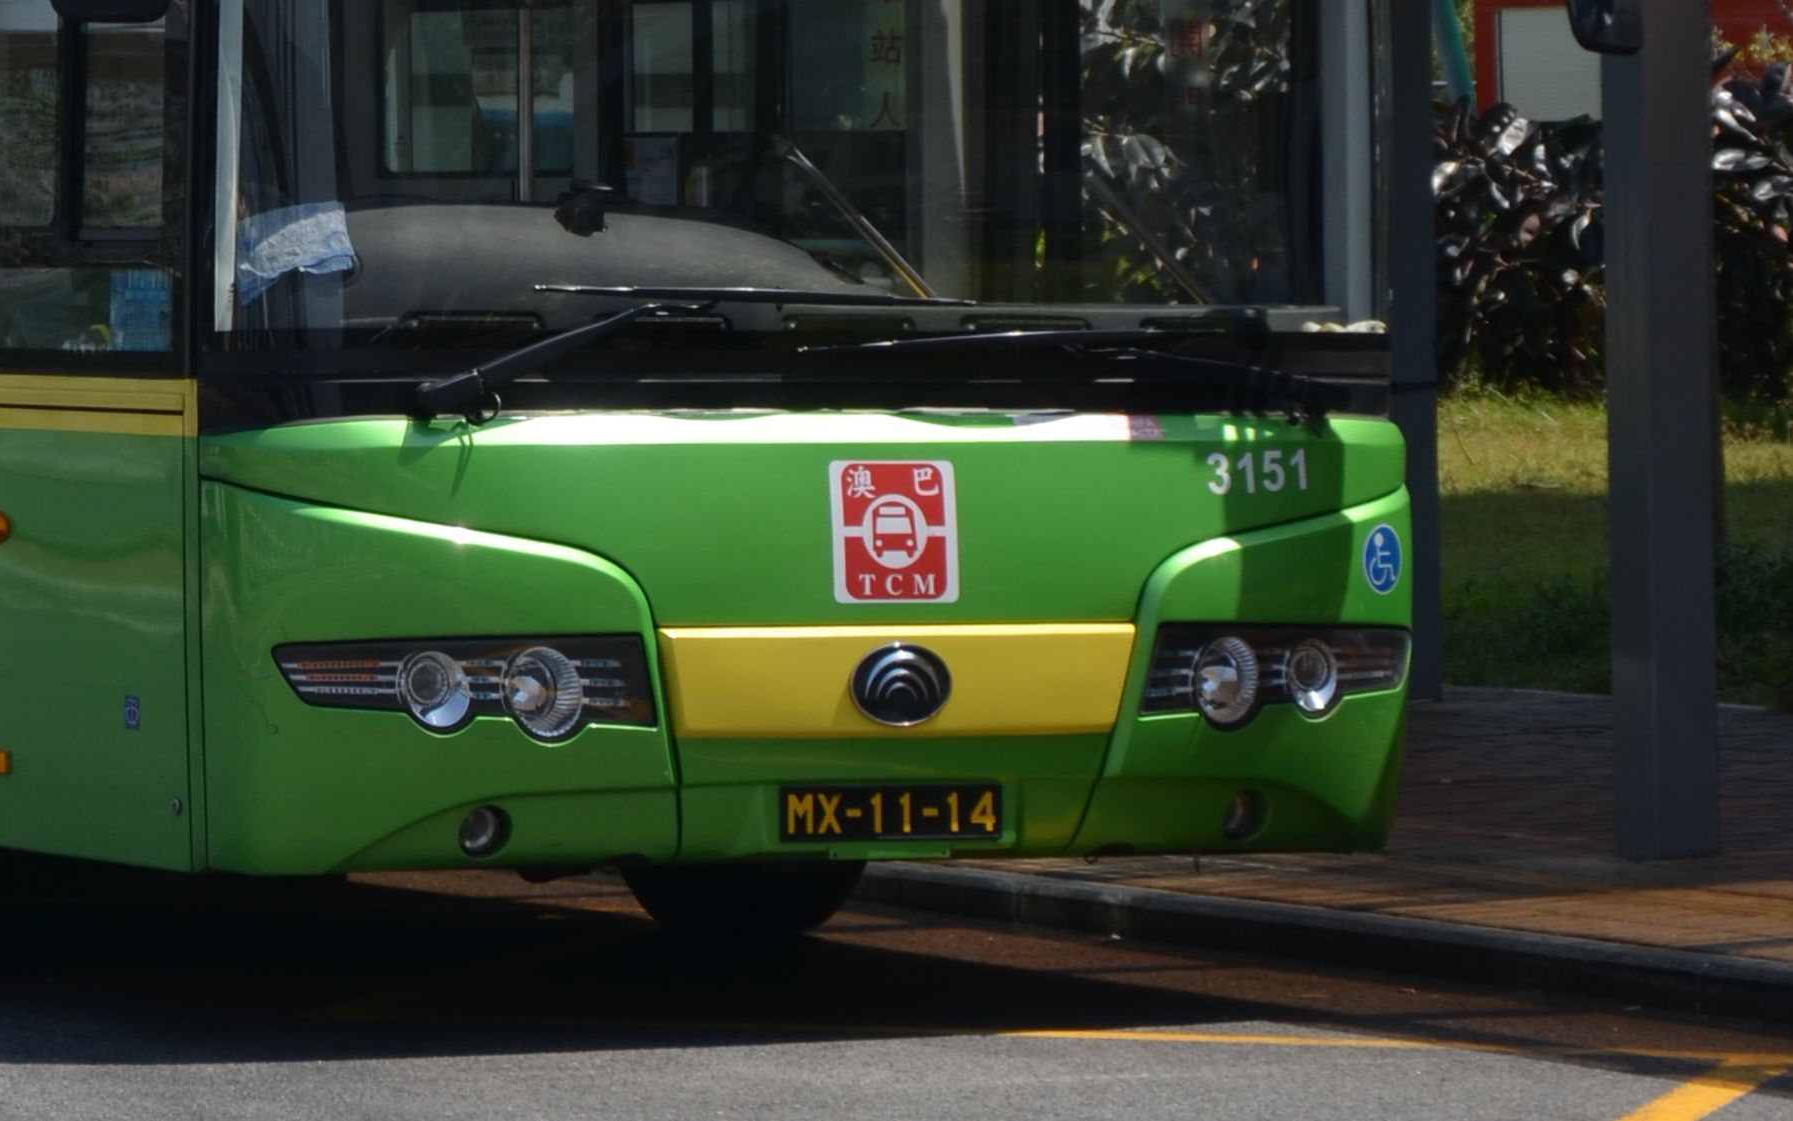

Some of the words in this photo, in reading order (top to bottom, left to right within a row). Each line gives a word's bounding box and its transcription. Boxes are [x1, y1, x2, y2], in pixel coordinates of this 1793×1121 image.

[1206, 449, 1308, 495] 3151
[858, 573, 936, 595] TCM
[786, 790, 996, 835] MX-11-14
